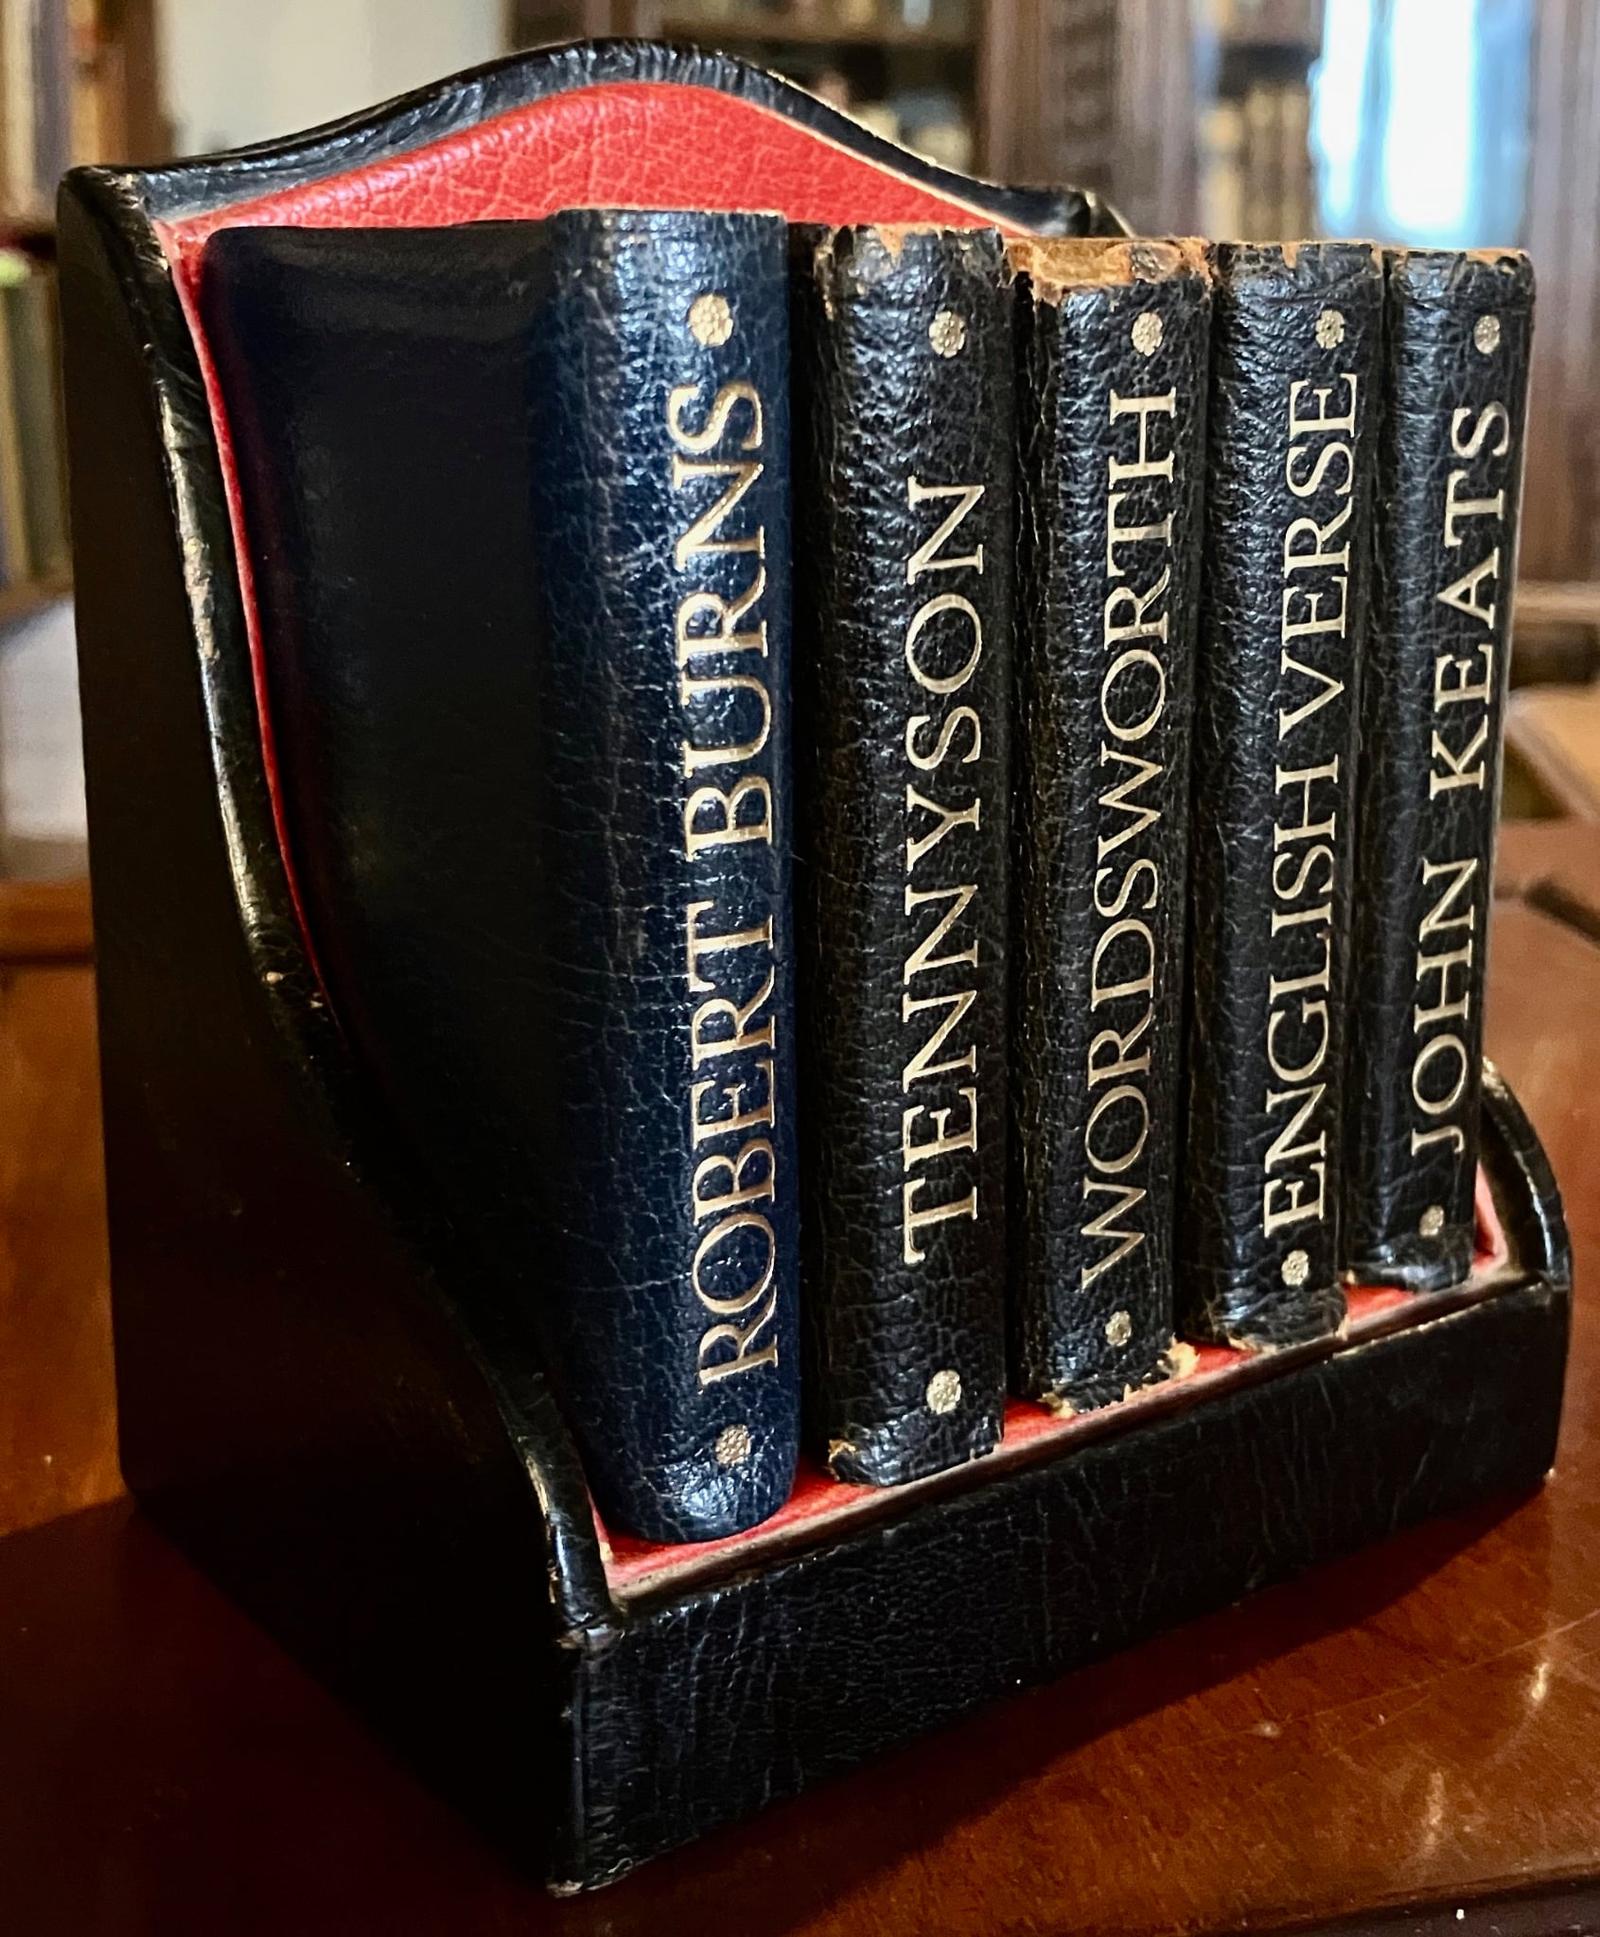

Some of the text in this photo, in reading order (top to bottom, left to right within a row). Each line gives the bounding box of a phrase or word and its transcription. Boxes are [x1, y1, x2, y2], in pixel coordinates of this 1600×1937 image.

[666, 381, 778, 1387] ROBERT BURNS
[902, 475, 985, 1265] TENNYSON
[1080, 386, 1177, 1290] WORDSWORTH
[1263, 372, 1358, 1239] ENGLISH VERSE
[1410, 400, 1510, 1158] JOHN KEATS
